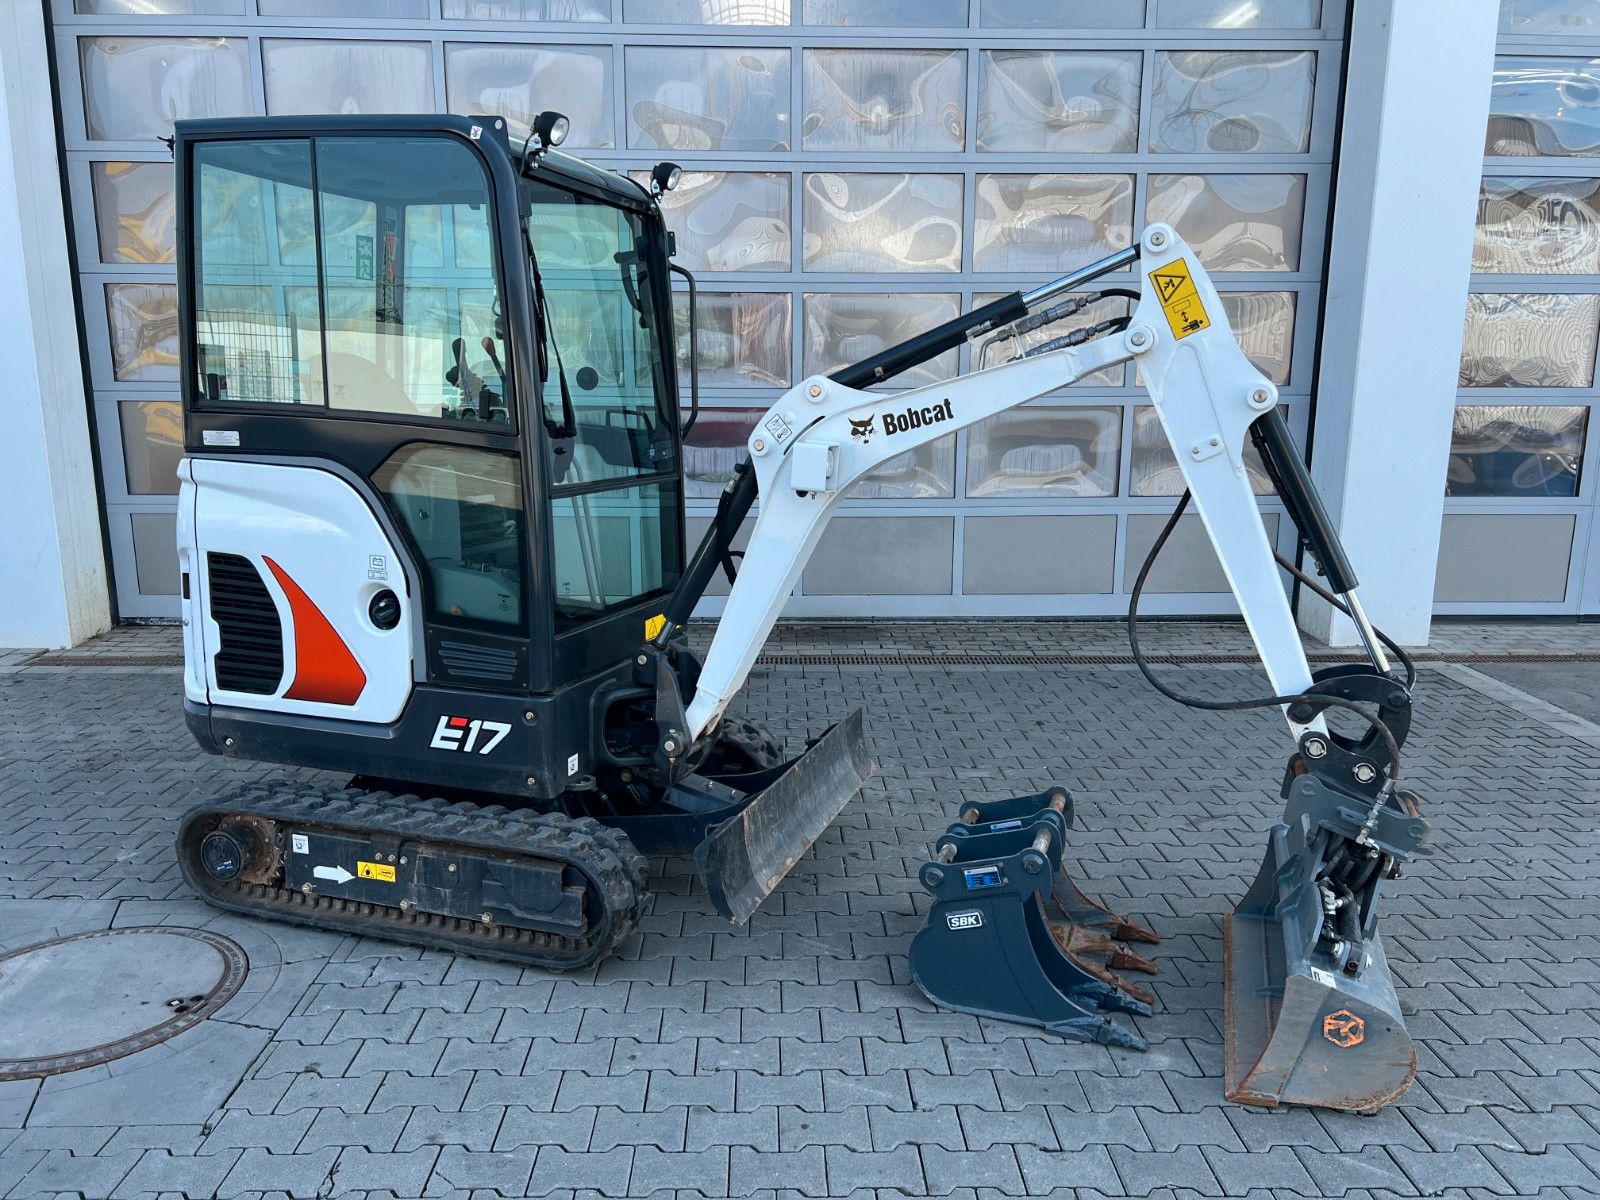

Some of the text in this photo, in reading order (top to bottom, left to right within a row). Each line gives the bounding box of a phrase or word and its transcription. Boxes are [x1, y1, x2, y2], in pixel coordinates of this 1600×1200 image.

[882, 398, 954, 436] Bobcat
[430, 715, 512, 755] E17
[951, 915, 977, 927] SBK
